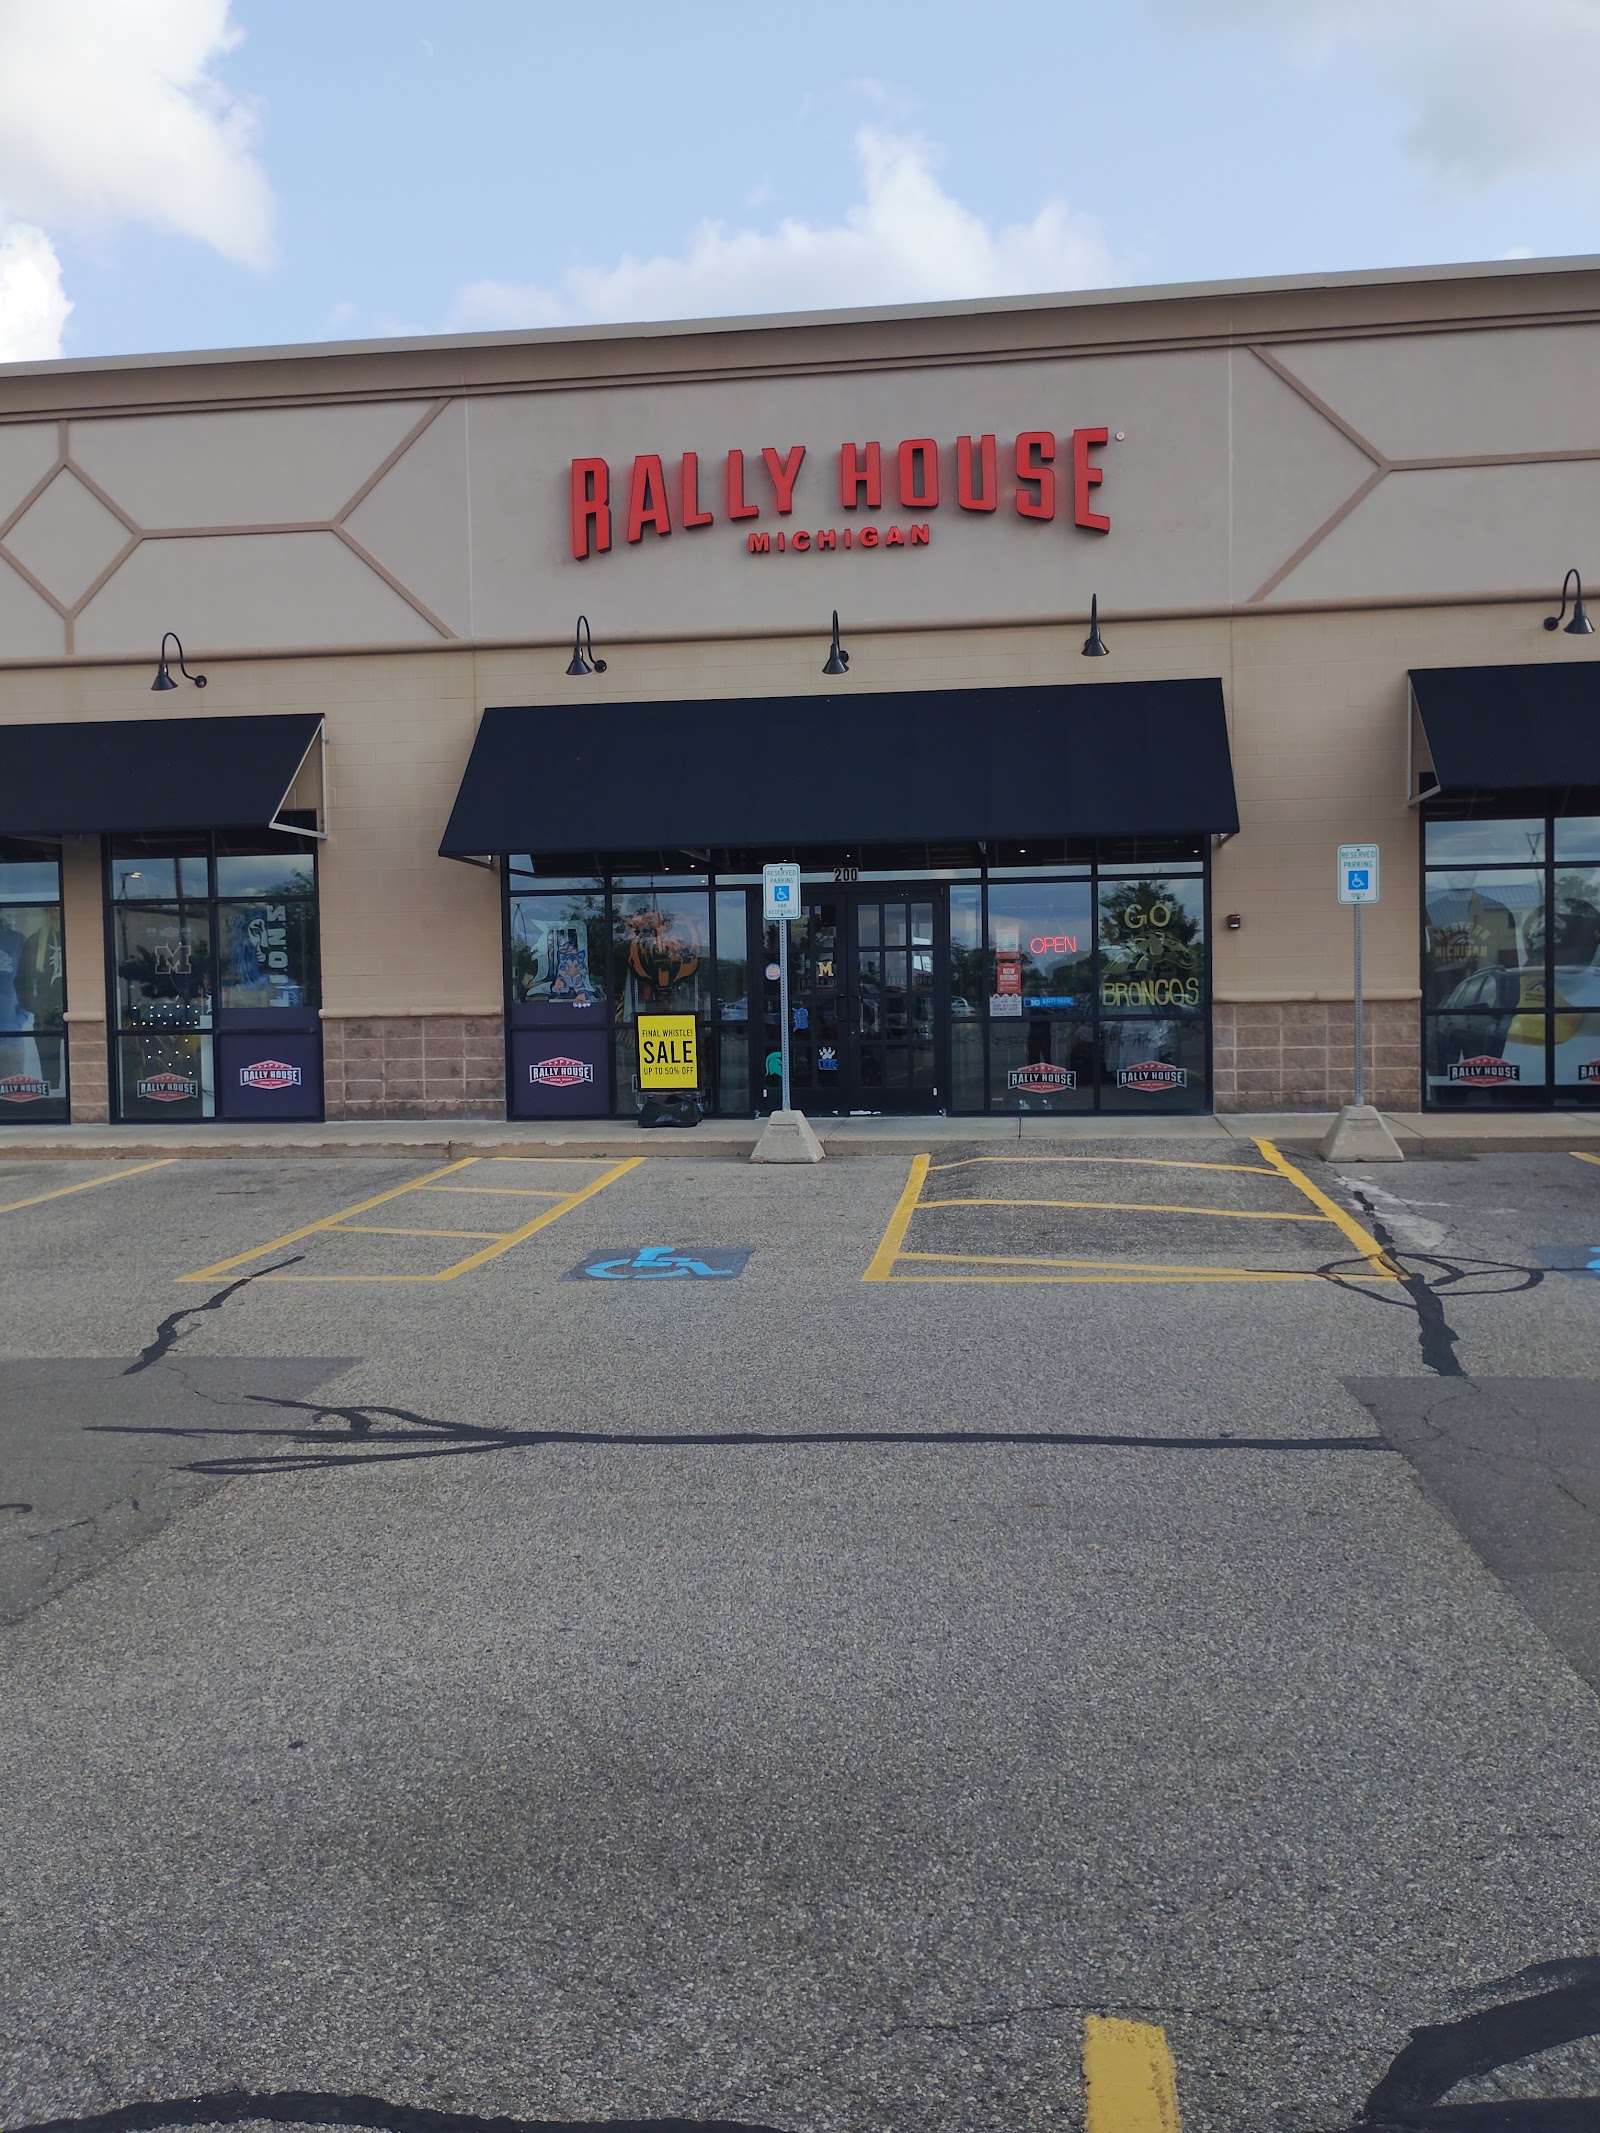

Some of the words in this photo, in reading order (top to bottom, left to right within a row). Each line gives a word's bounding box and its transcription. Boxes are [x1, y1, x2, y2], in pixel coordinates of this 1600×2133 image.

[571, 445, 806, 560] RALLY
[841, 427, 1110, 535] HOUSE
[748, 523, 930, 554] MICHIGAN
[1341, 850, 1376, 859] RESERVED
[1343, 860, 1374, 869] PARKING
[767, 869, 796, 877] RESERVED
[834, 868, 858, 882] 200
[1124, 902, 1171, 929] GO
[1030, 936, 1077, 954] OPEN
[1435, 945, 1488, 958] MICHIGAN
[155, 945, 192, 975] M
[266, 905, 290, 1007] LIONS
[818, 961, 834, 977] M
[1002, 967, 1015, 975] NOW
[1102, 977, 1199, 1007] BRONCOS
[642, 1029, 661, 1037] FINAL
[662, 1029, 693, 1037] WHISTLE!
[643, 1040, 694, 1064] SALE
[243, 1069, 269, 1082] RALLY
[270, 1069, 298, 1082] HOUSE
[533, 1066, 559, 1079] RALLY
[560, 1066, 590, 1079] HOUSE
[643, 1067, 653, 1075] UP
[655, 1067, 663, 1075] TO
[665, 1066, 680, 1075] 50%
[682, 1066, 694, 1075] OFF
[1452, 1066, 1481, 1079] RALLY
[1484, 1066, 1517, 1079] HOUSE
[1012, 1073, 1039, 1086] RALLY
[1042, 1073, 1072, 1086] HOUSE
[1121, 1071, 1148, 1084] RALLY
[1152, 1071, 1182, 1084] HOUSE
[21, 1083, 48, 1095] HOUSE
[141, 1083, 165, 1095] RALLY
[166, 1083, 195, 1095] HOUSE
